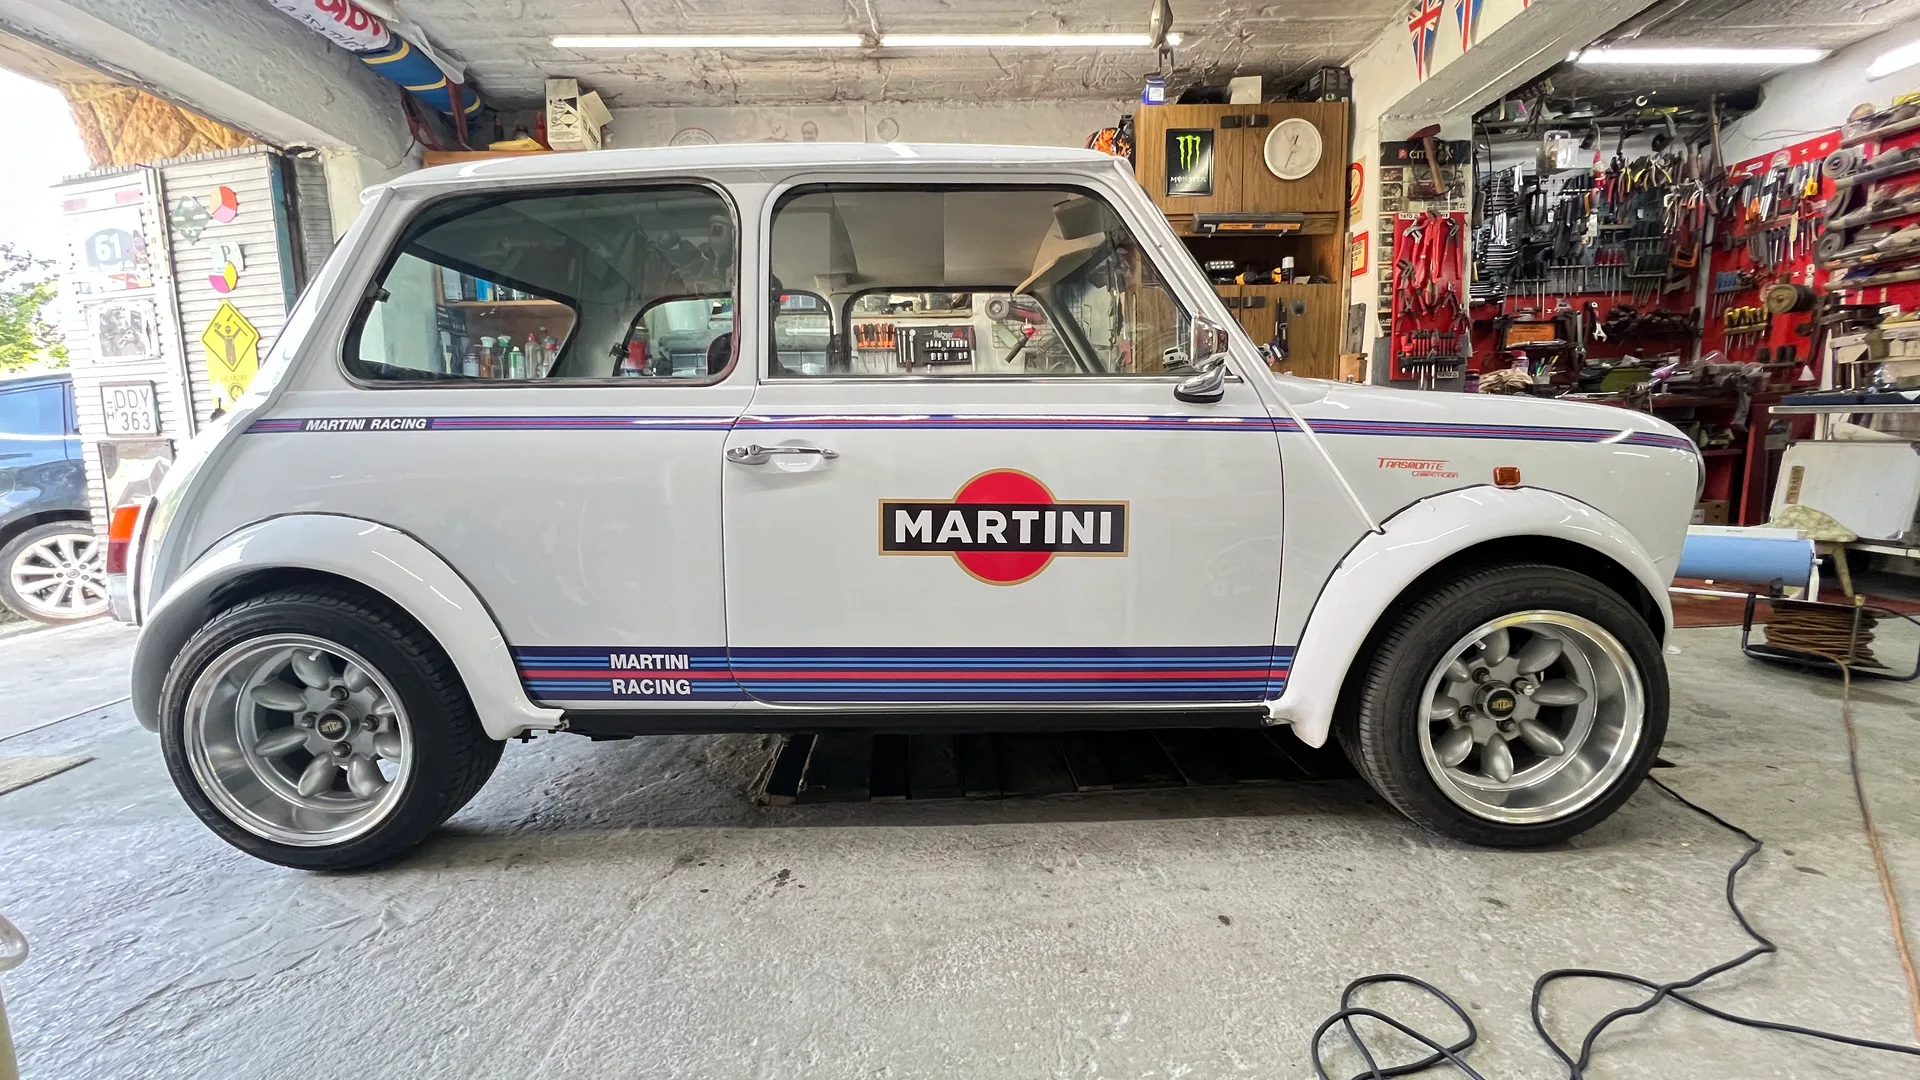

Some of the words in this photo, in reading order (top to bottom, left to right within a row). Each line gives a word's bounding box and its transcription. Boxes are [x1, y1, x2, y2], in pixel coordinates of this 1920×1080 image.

[94, 232, 122, 261] 61
[114, 388, 149, 409] DDY
[121, 411, 151, 431] 363
[305, 418, 366, 431] MARTINI
[370, 418, 427, 430] RACING
[895, 509, 1112, 545] MARTINI
[610, 653, 689, 670] MARTINI
[612, 679, 691, 695] RACING
